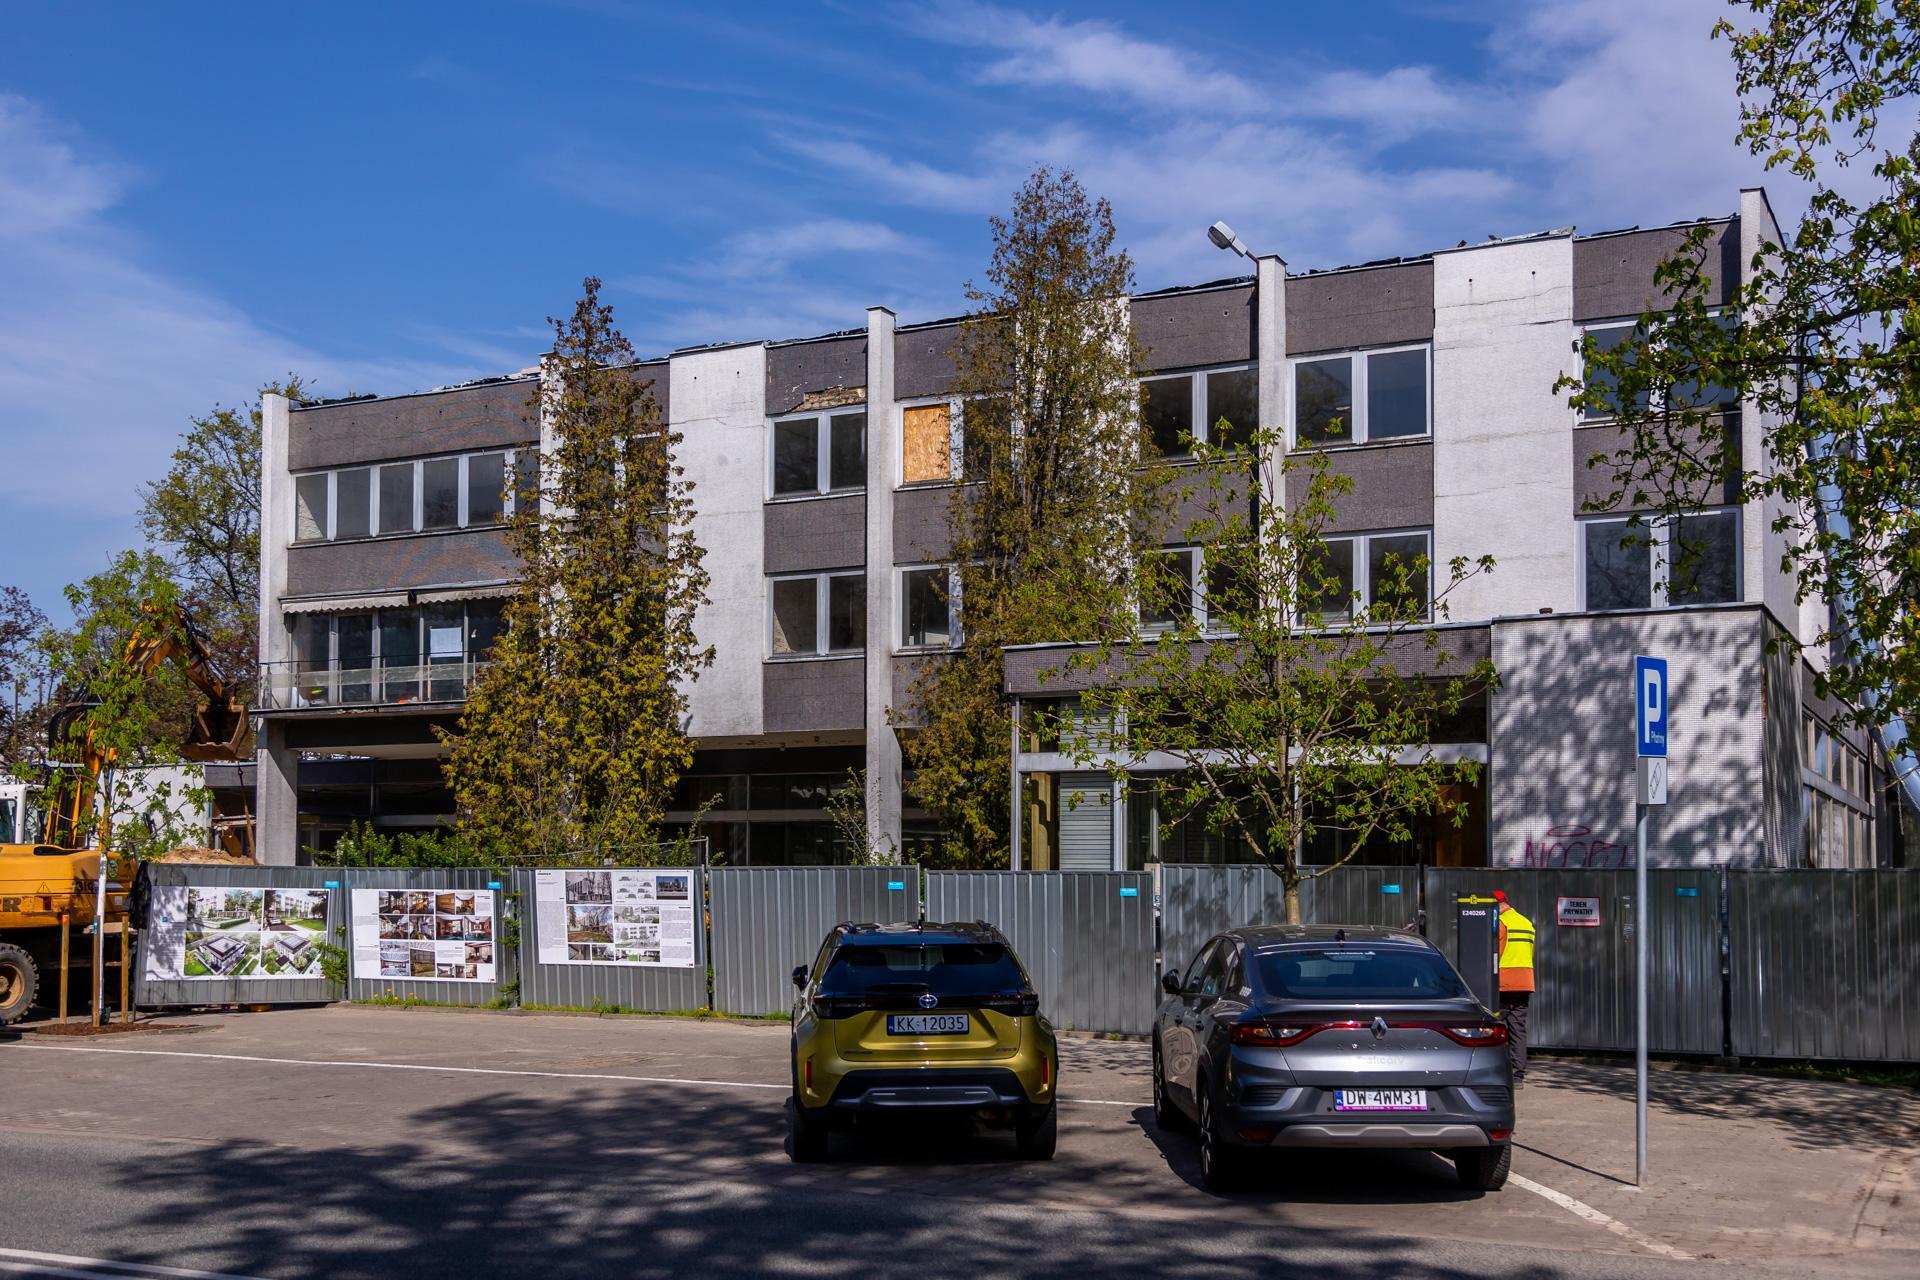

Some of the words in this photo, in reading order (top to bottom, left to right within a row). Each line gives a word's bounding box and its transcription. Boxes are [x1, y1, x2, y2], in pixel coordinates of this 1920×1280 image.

[1644, 669, 1662, 743] P
[897, 1016, 915, 1031] KK
[922, 1016, 964, 1031] 12035
[1346, 1090, 1366, 1105] DW
[1373, 1090, 1420, 1105] 4WM31
